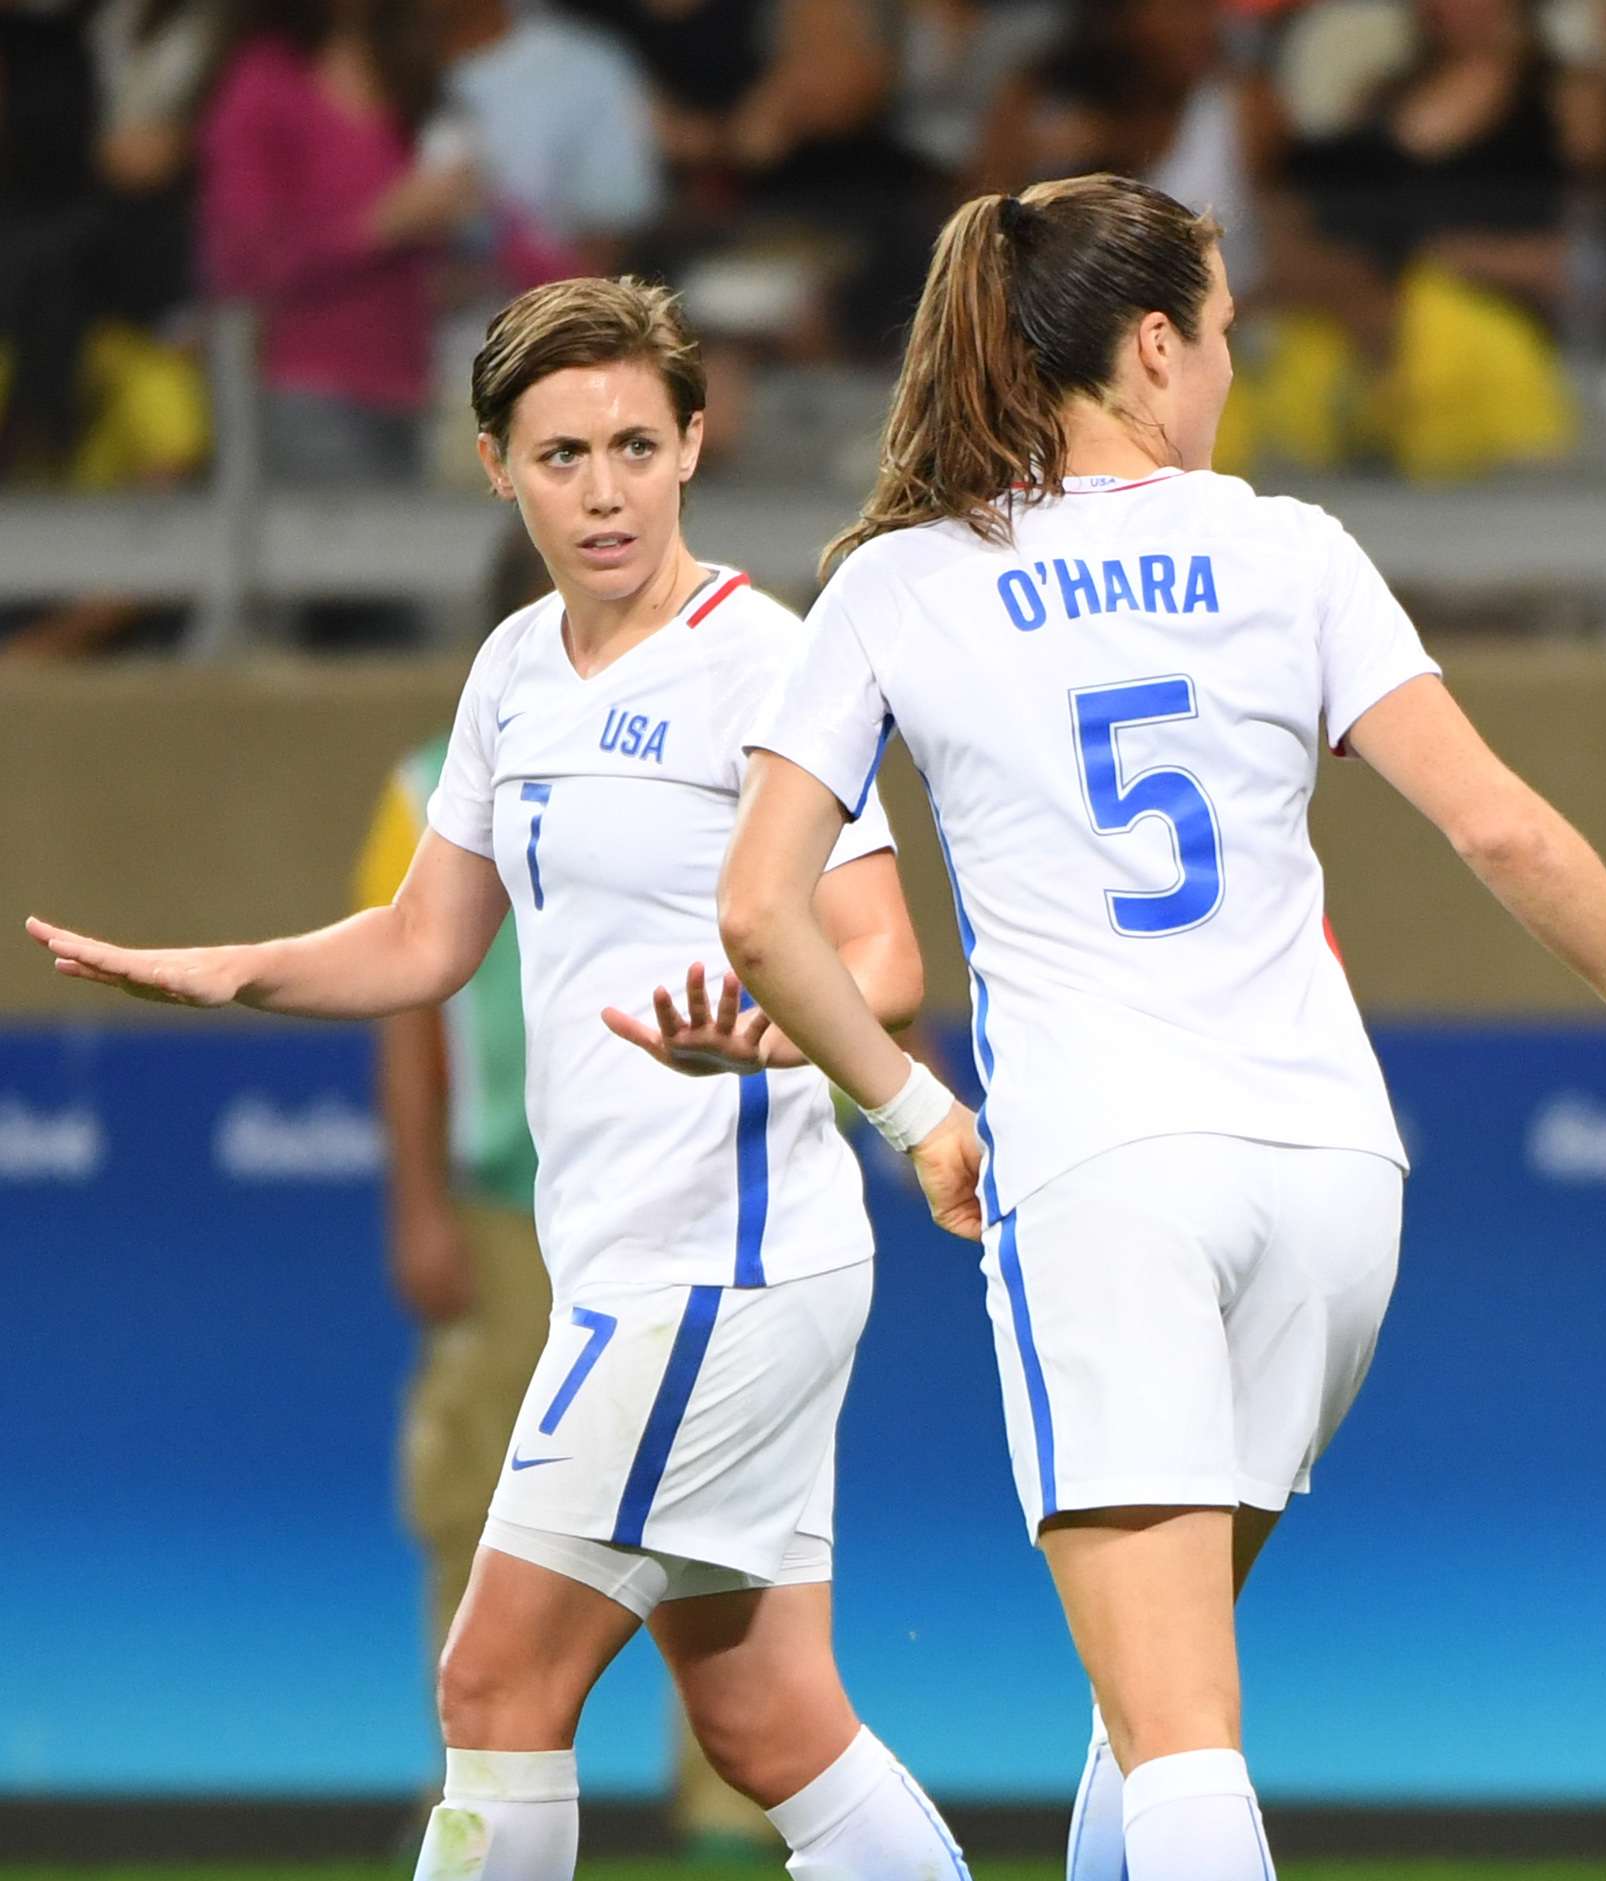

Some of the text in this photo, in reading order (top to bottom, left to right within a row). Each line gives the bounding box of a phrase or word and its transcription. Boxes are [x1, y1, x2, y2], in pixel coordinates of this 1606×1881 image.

[1090, 478, 1116, 487] USA
[997, 554, 1220, 632] O'HARA
[599, 707, 670, 765] USA
[520, 782, 552, 911] 7
[1067, 673, 1226, 939] 5
[538, 1305, 618, 1436] 7
